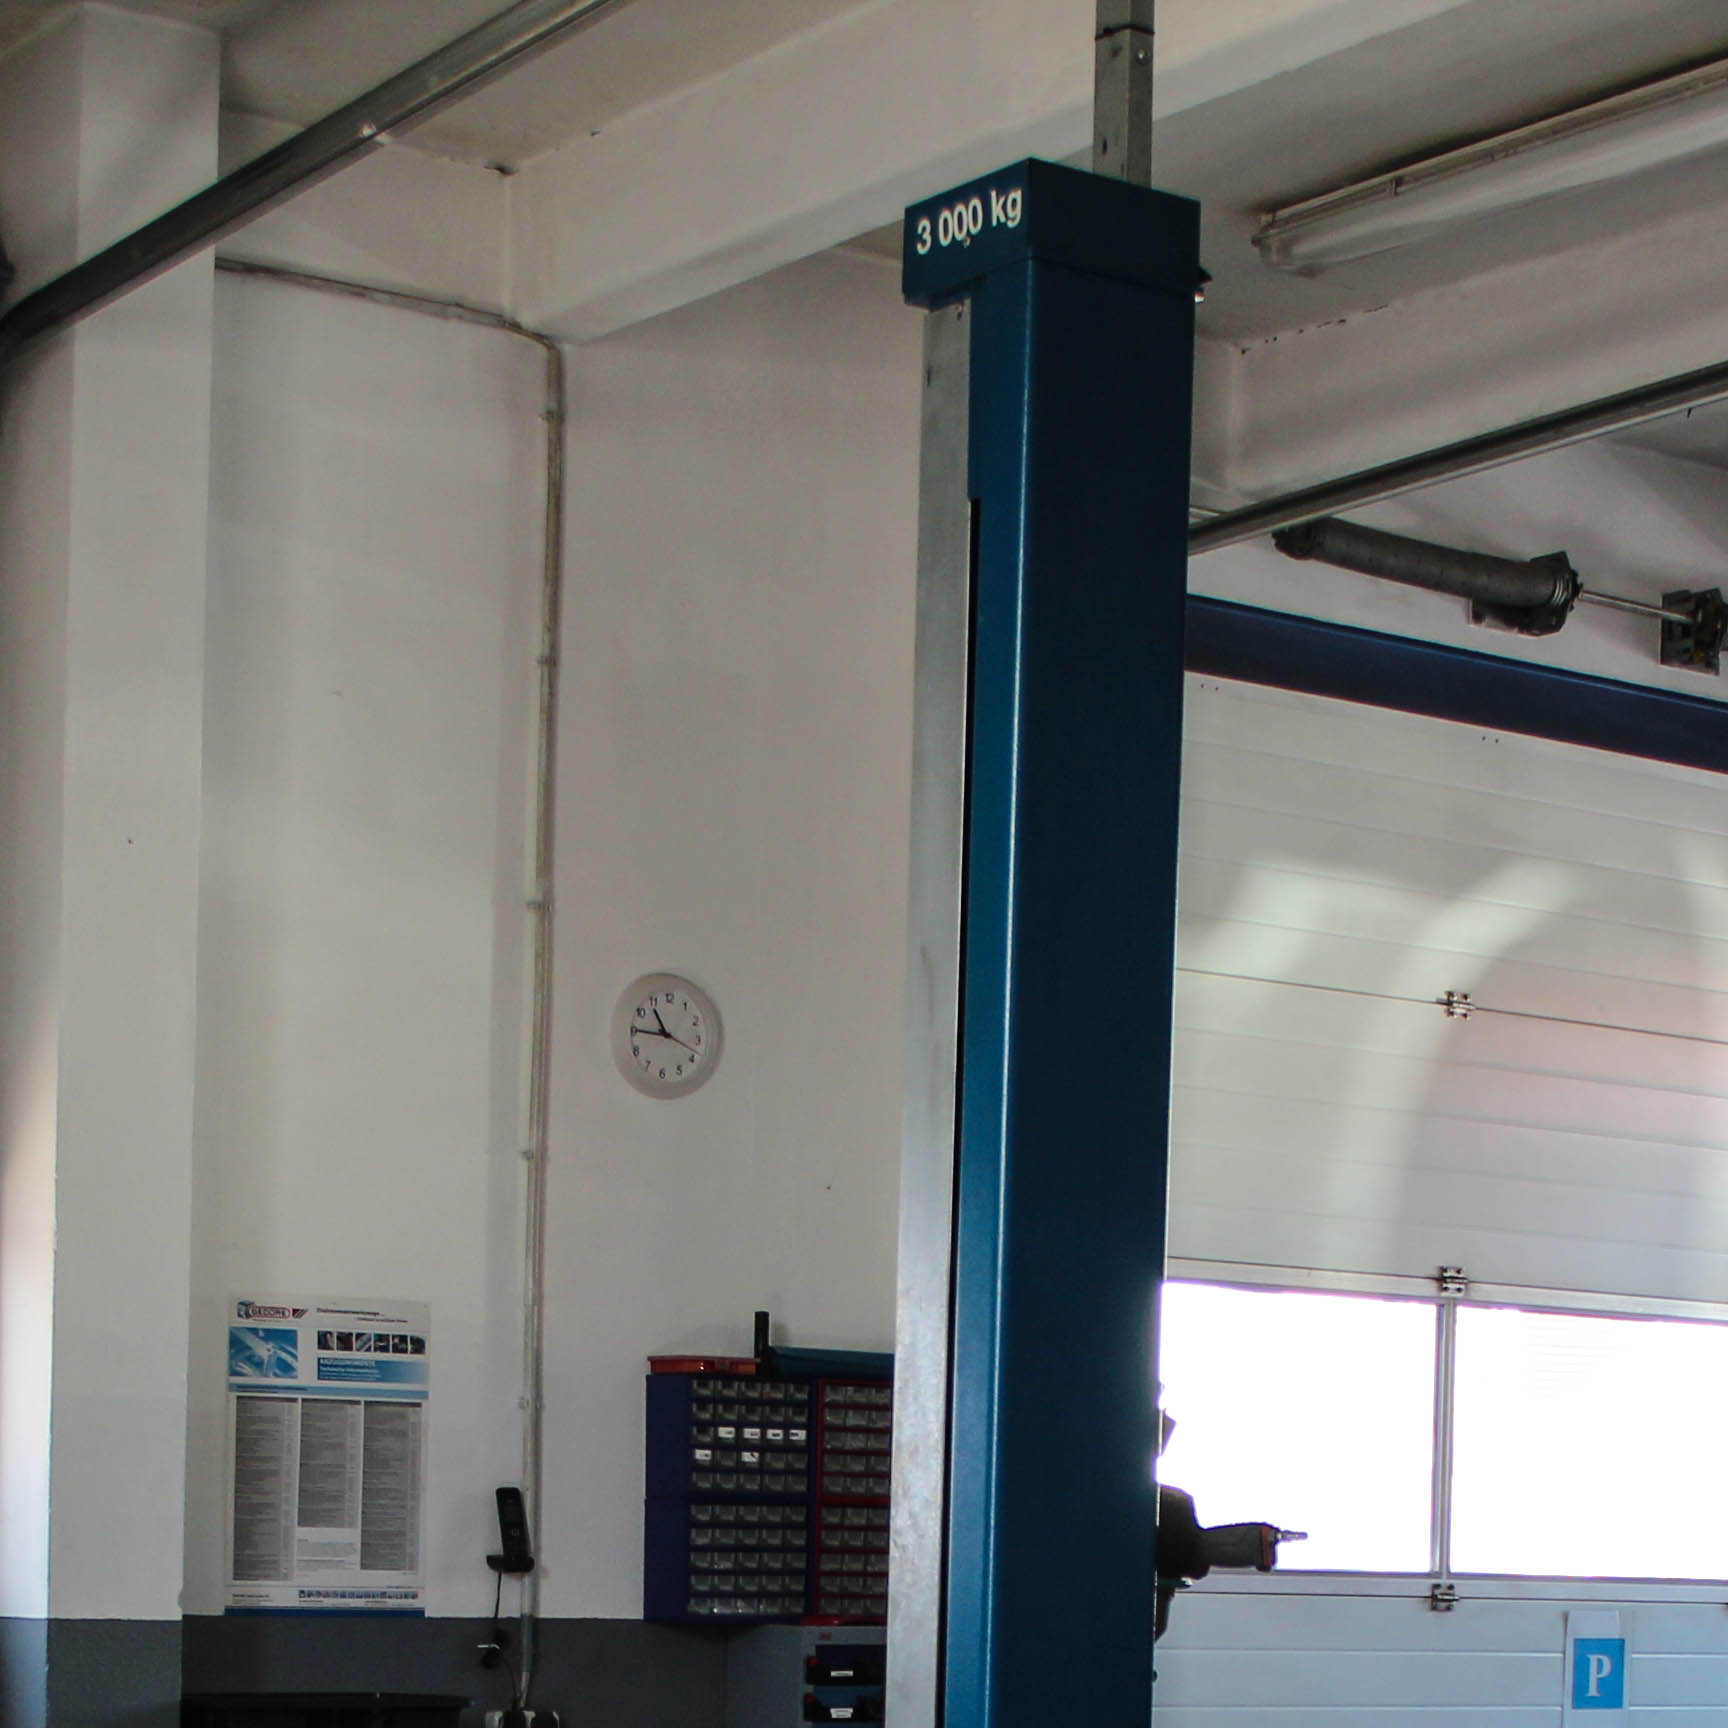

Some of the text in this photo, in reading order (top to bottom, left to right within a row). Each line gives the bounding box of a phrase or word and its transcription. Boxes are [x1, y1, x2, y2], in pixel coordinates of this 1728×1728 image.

[917, 188, 1022, 254] 3 000 kg
[1585, 1654, 1612, 1697] P
